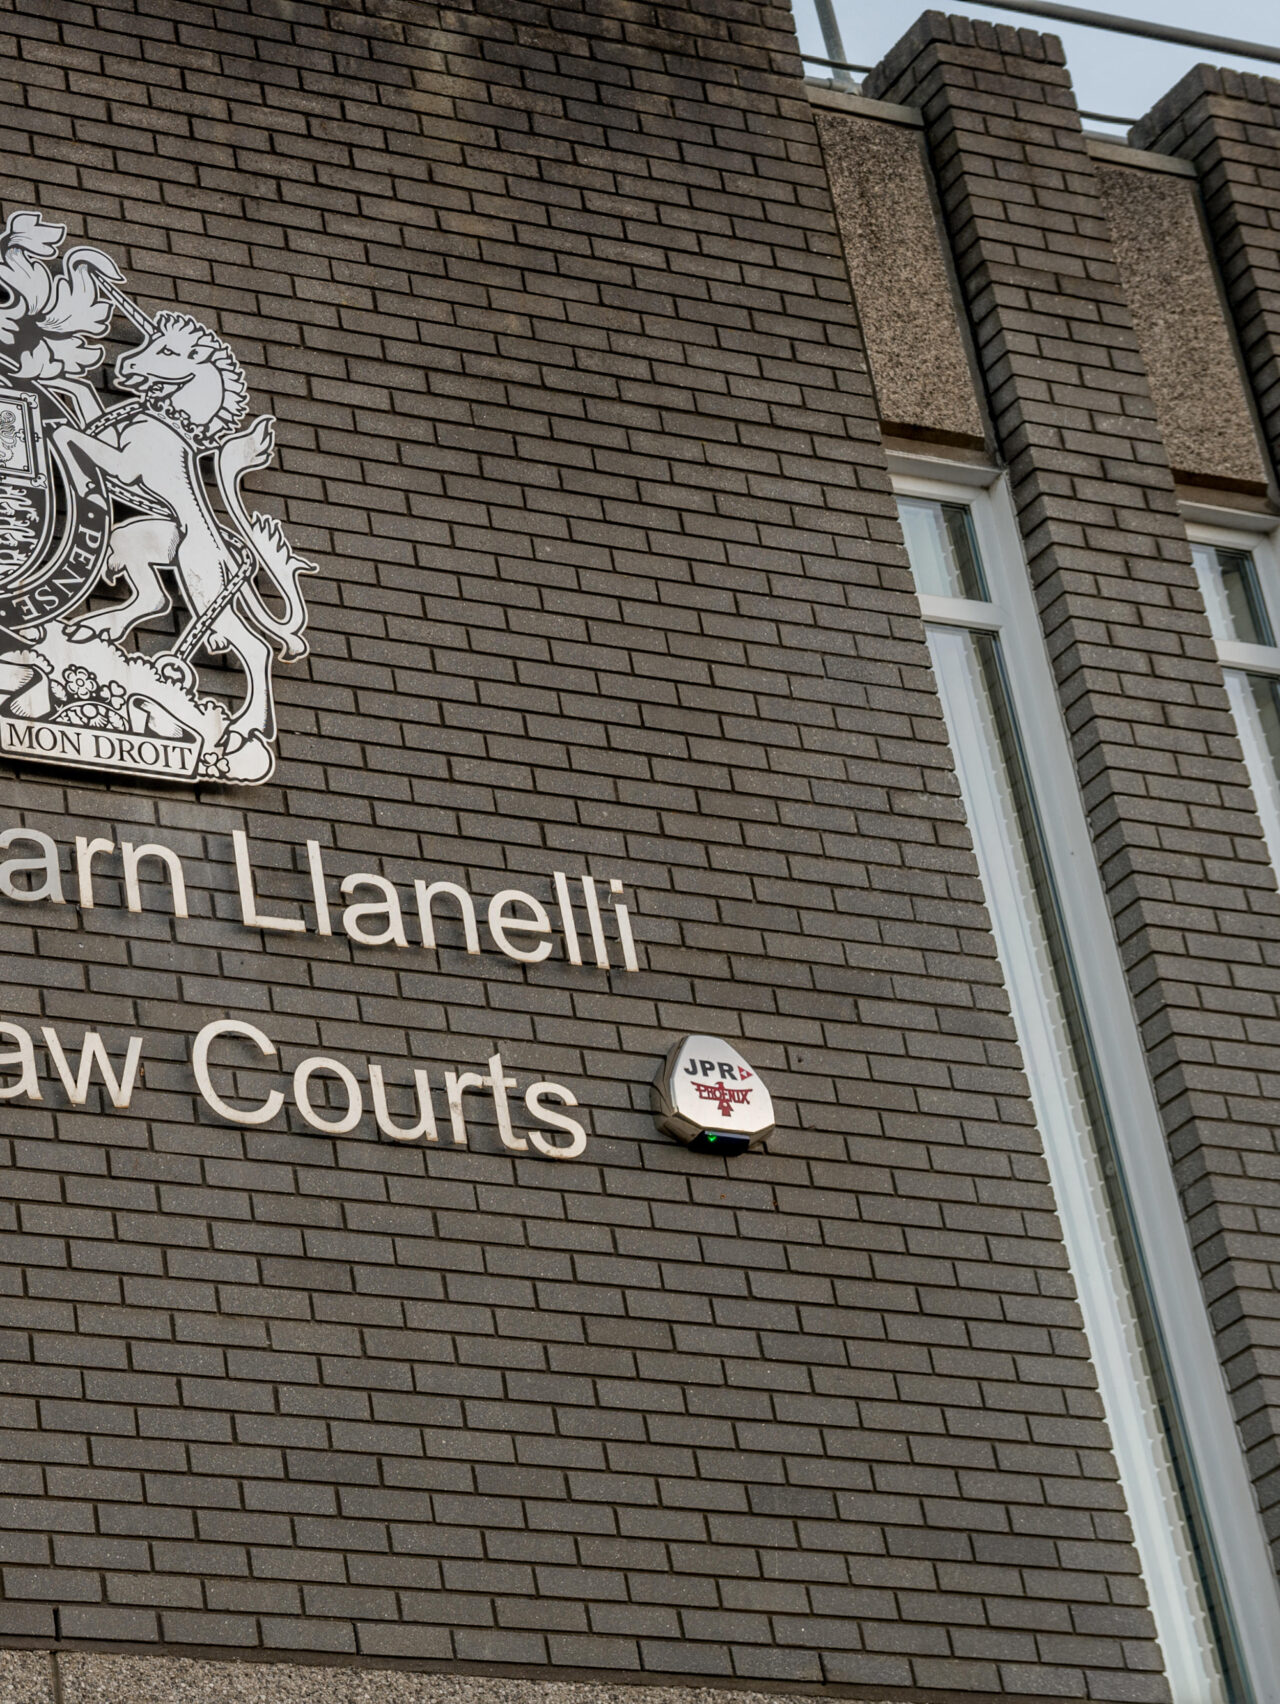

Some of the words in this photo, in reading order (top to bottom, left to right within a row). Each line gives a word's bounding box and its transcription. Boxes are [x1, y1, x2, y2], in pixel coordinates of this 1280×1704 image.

[11, 524, 102, 620] PENSE
[6, 722, 82, 756] MON
[91, 734, 193, 770] DROIT
[231, 829, 640, 972] Llanelli
[192, 1018, 589, 1160] Courts
[683, 1058, 738, 1081] JPR
[691, 1081, 753, 1105] PHOENIX
